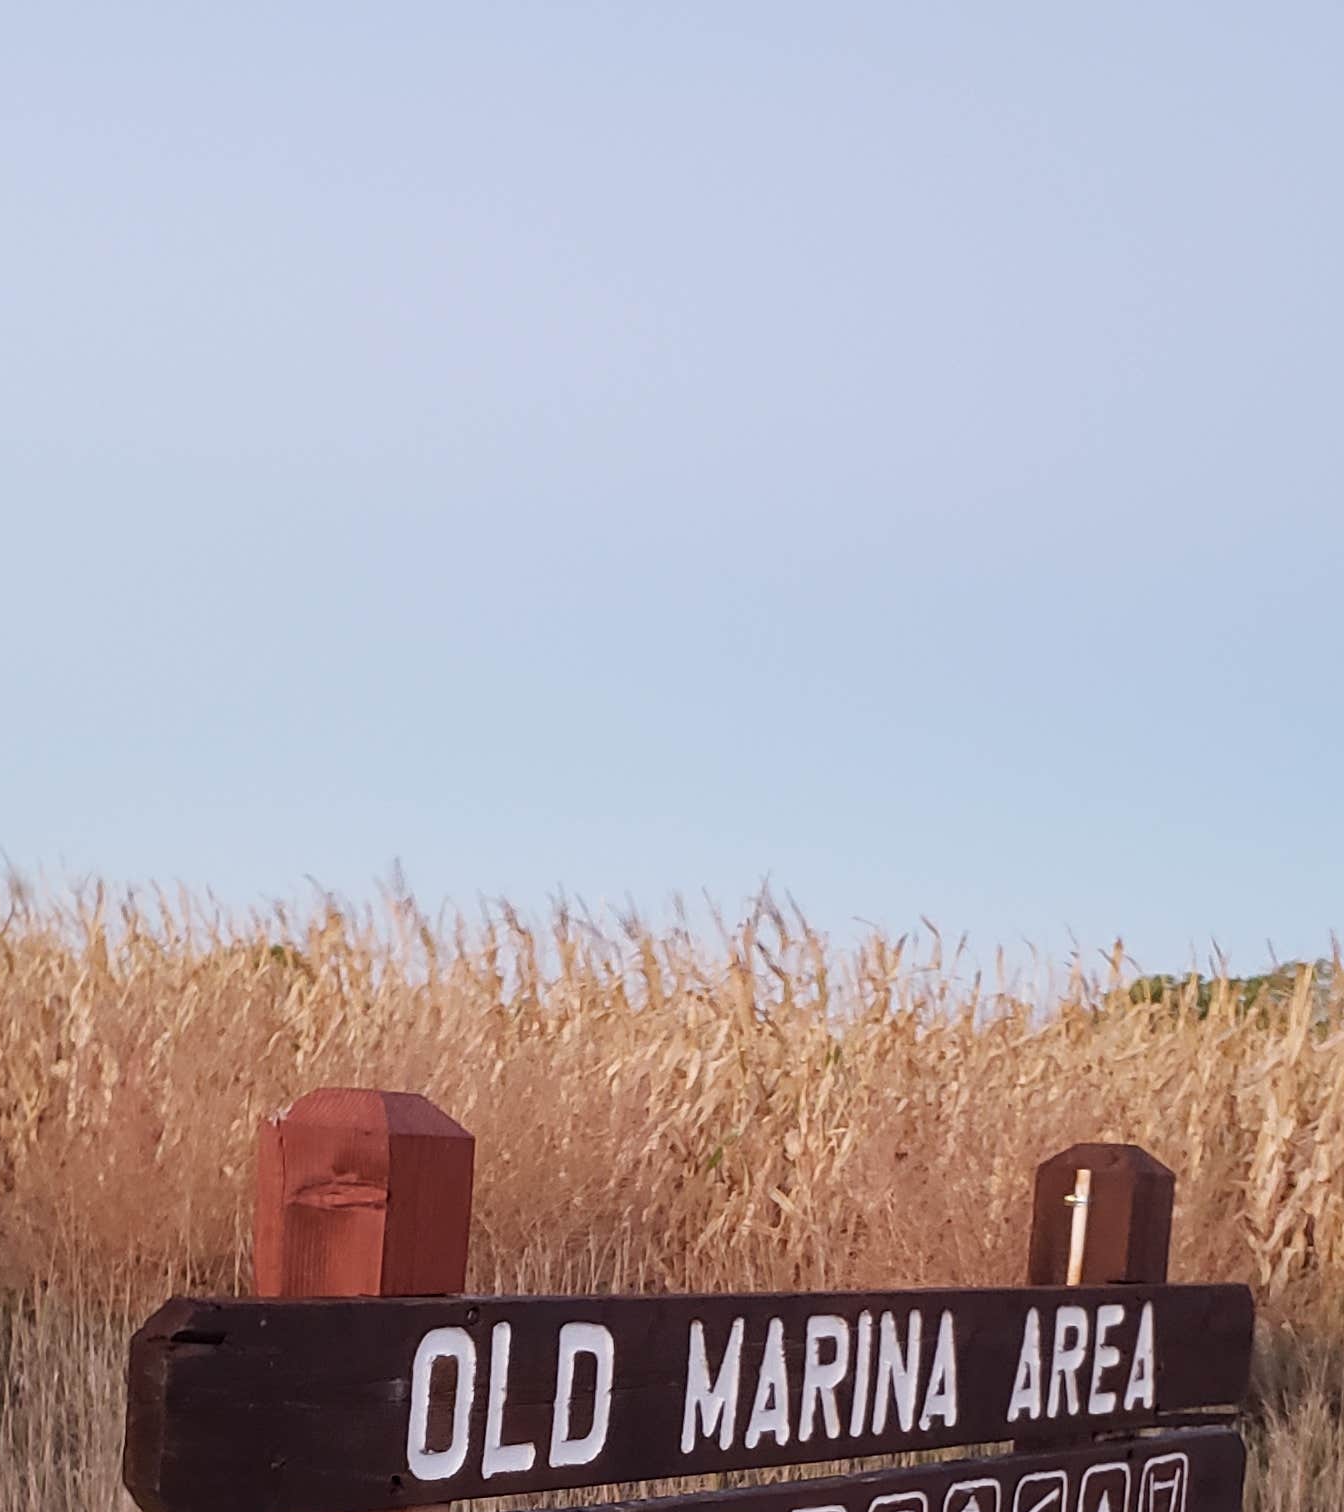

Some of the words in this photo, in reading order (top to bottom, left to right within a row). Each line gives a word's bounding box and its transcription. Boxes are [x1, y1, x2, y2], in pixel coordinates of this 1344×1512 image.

[406, 1321, 615, 1481] OLD
[680, 1309, 958, 1454] MARINA
[1007, 1301, 1155, 1422] AREA
